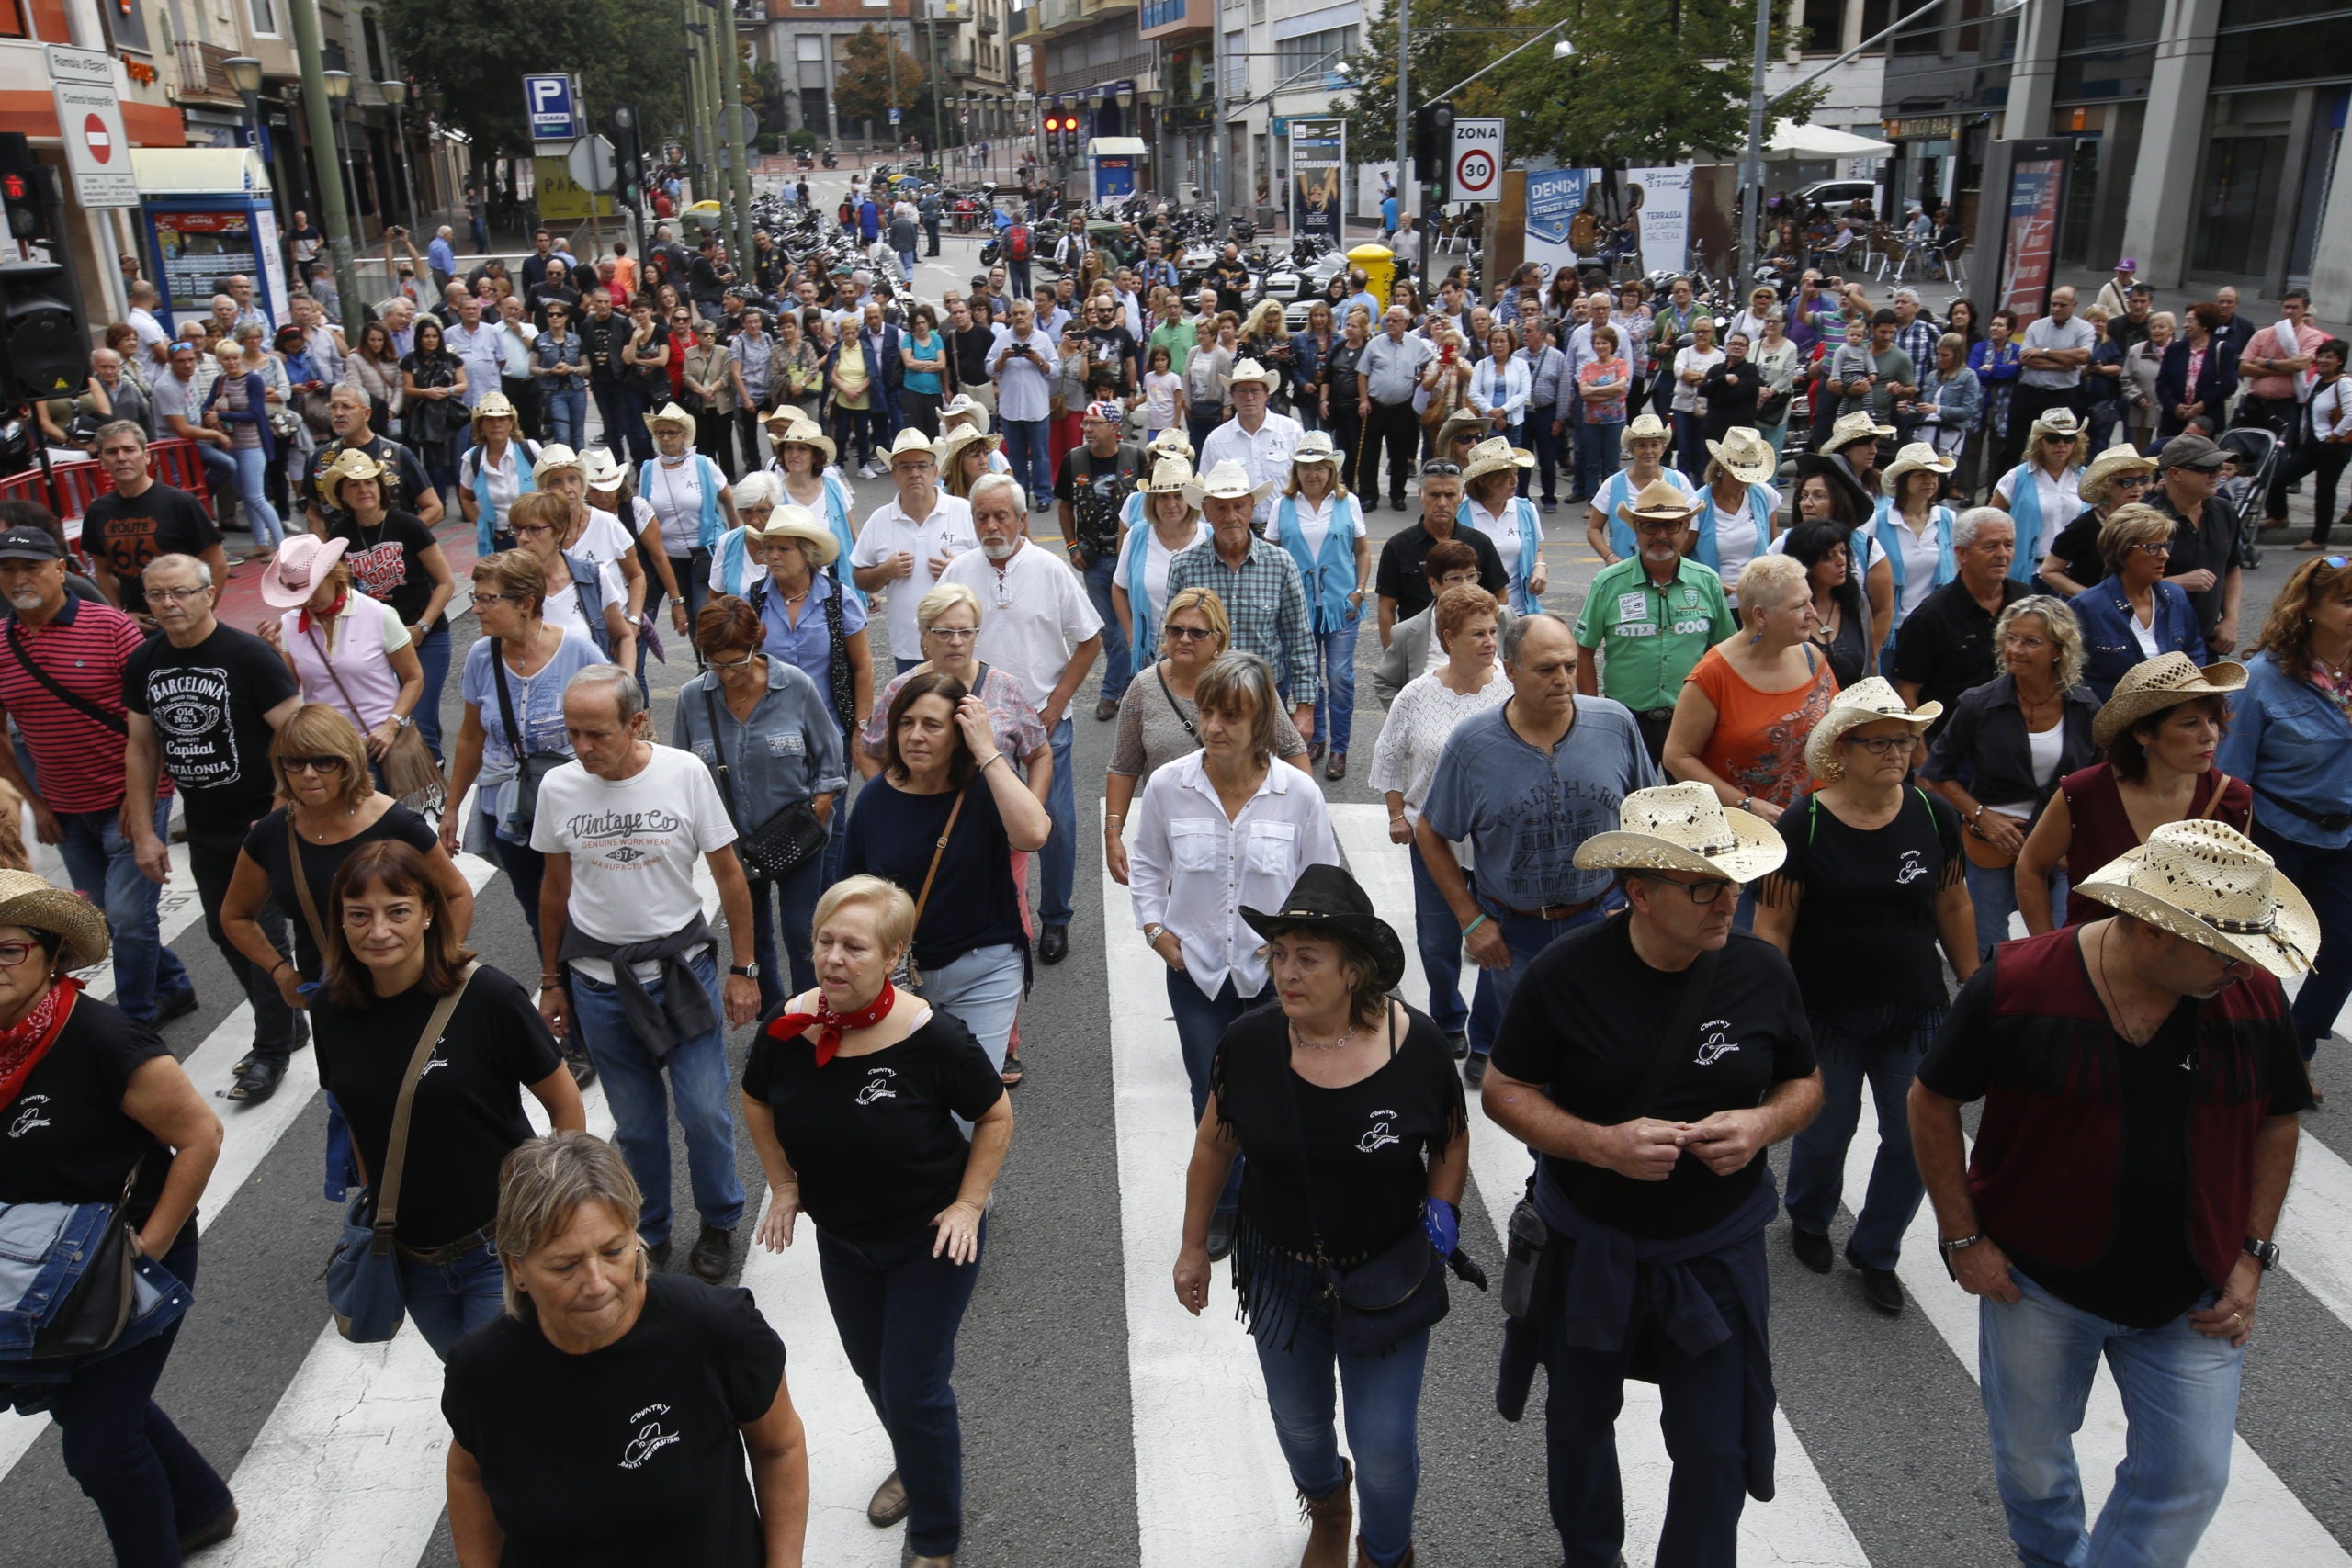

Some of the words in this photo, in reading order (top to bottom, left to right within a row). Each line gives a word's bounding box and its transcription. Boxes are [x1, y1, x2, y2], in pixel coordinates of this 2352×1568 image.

[1457, 127, 1498, 139] ZONA
[1465, 164, 1487, 177] 30
[1532, 177, 1580, 198] DENIM
[1532, 201, 1563, 216] STREET
[1563, 198, 1581, 209] LIFE
[110, 522, 150, 533] ROUTE
[111, 537, 153, 570] 66
[1614, 623, 1657, 637] PETER
[150, 676, 225, 703] BARCELONA
[176, 707, 194, 716] Old
[175, 715, 198, 724] No.1
[166, 740, 216, 759] Capital
[567, 808, 643, 840] Vintage
[582, 838, 618, 850] GENUINE
[619, 838, 644, 847] WORK
[646, 838, 671, 846] WEAR
[591, 855, 662, 871] MANUFACTURING
[1700, 1019, 1731, 1031] COUNTRY
[867, 1067, 897, 1077] COUNTRY
[20, 1094, 51, 1105] COUNTRY
[1370, 1109, 1398, 1119] COUNTRY
[630, 1404, 671, 1424] COUNTRY
[618, 1461, 642, 1470] BARRI
[643, 1436, 680, 1461] UNIVERSITARI
